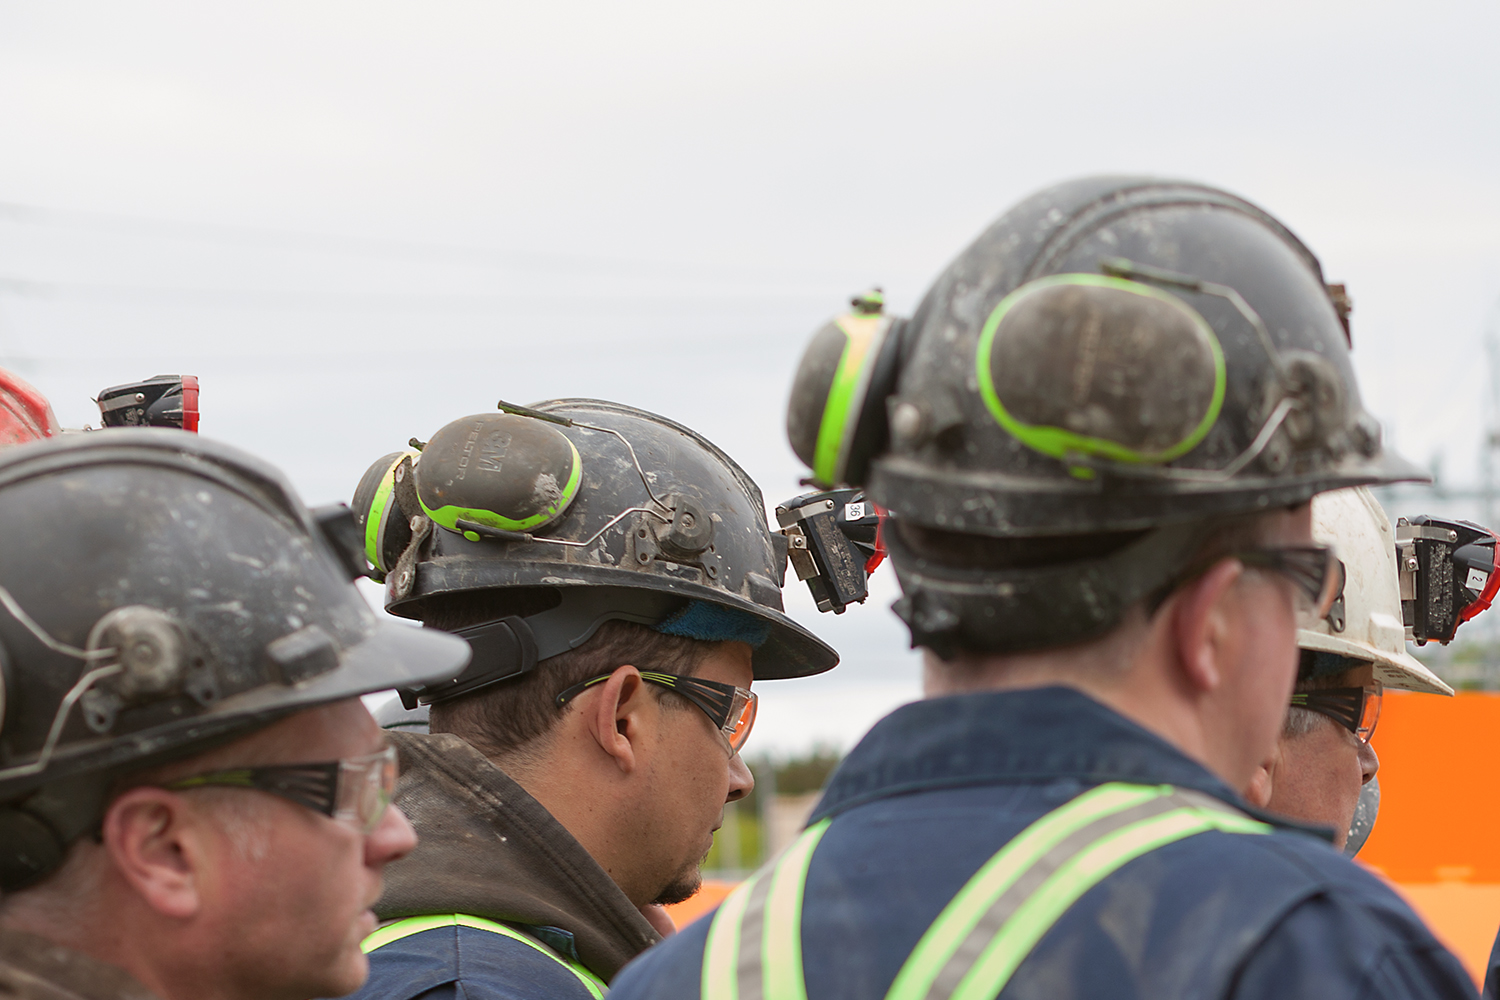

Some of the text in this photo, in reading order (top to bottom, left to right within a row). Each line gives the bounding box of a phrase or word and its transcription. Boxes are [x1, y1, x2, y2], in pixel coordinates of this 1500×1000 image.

[455, 420, 484, 480] PELTOR
[478, 429, 513, 473] 3M
[849, 504, 861, 517] 36
[1471, 575, 1483, 583] 2
